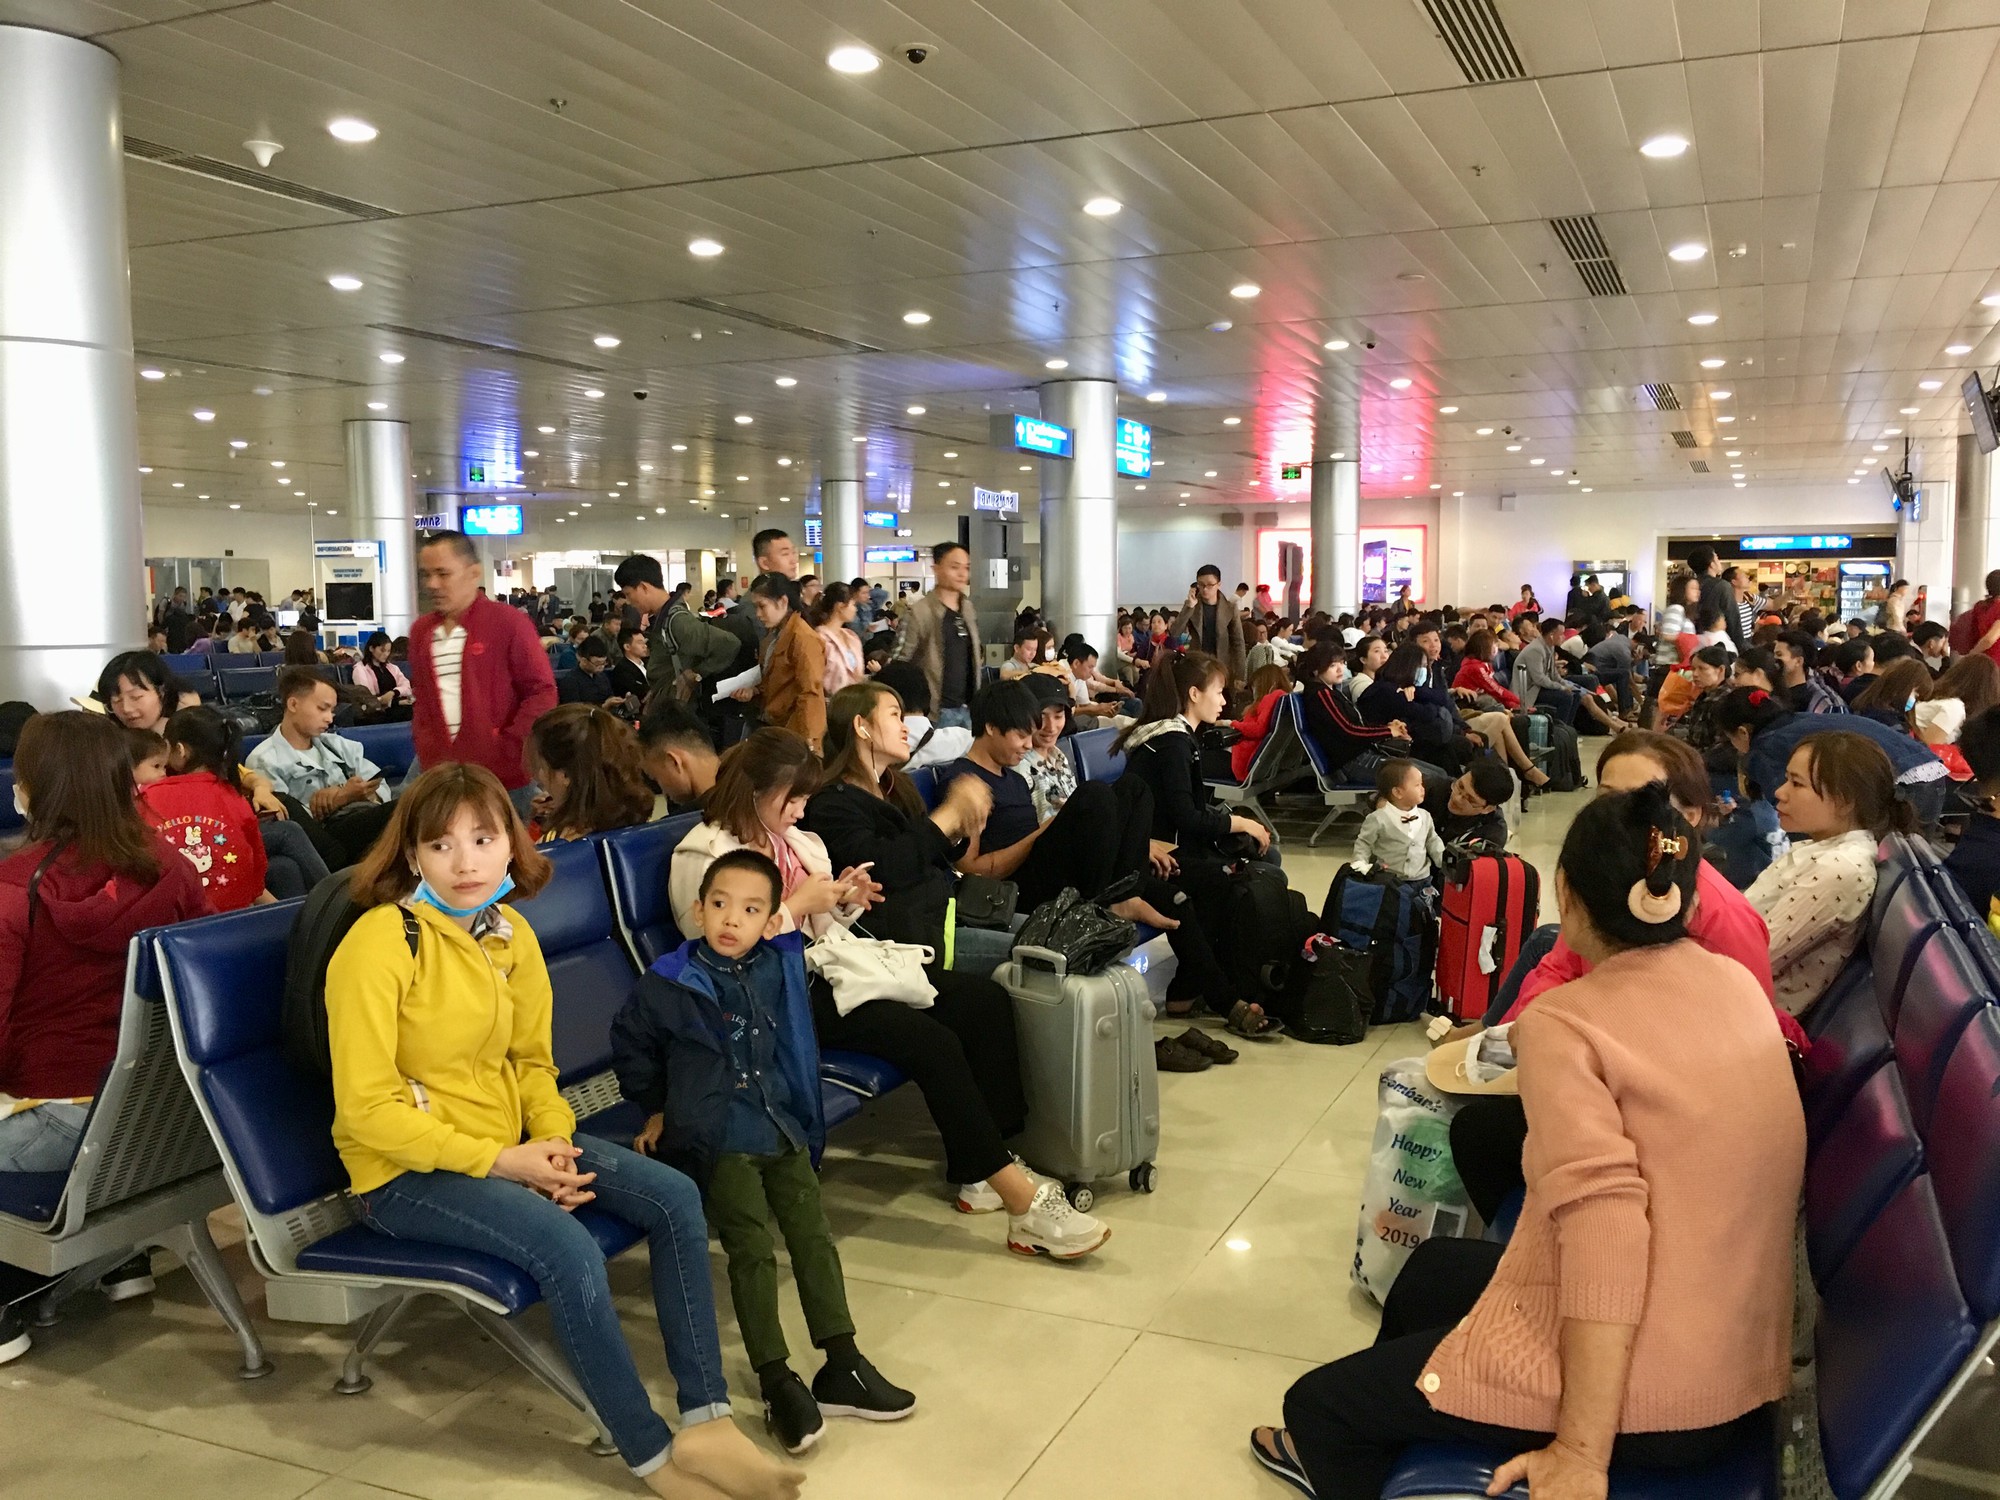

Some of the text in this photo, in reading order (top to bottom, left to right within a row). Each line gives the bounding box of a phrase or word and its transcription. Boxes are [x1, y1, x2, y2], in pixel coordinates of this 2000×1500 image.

[195, 815, 228, 831] KITTY
[1380, 1073, 1442, 1113] combank
[1391, 1133, 1443, 1162] Happy
[1393, 1168, 1427, 1189] New
[1388, 1197, 1422, 1219] Year
[1380, 1226, 1420, 1249] 2019
